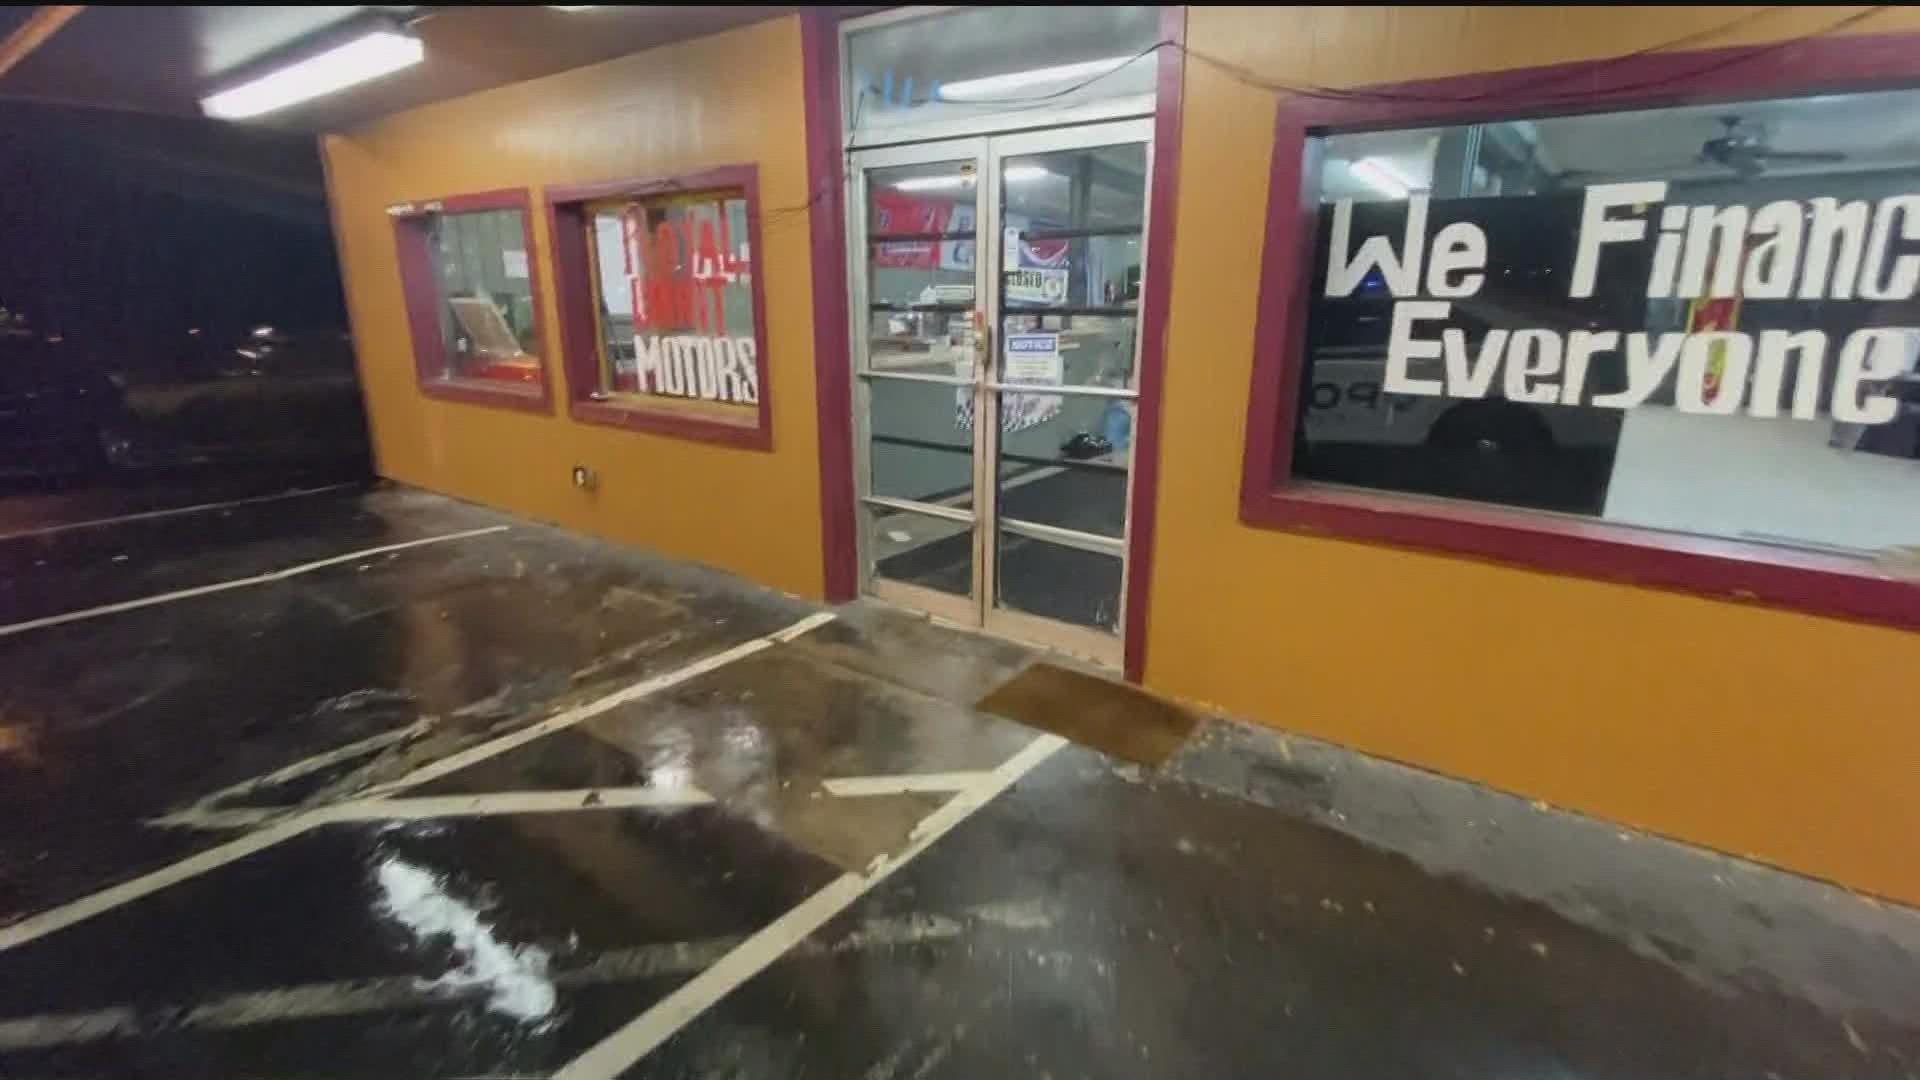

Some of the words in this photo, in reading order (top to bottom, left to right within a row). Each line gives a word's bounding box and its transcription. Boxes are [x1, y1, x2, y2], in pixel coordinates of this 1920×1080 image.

[1325, 192, 1488, 298] We
[1569, 180, 1920, 299] Financ
[633, 334, 759, 404] MOTORS
[1384, 300, 1917, 424] Everyone
